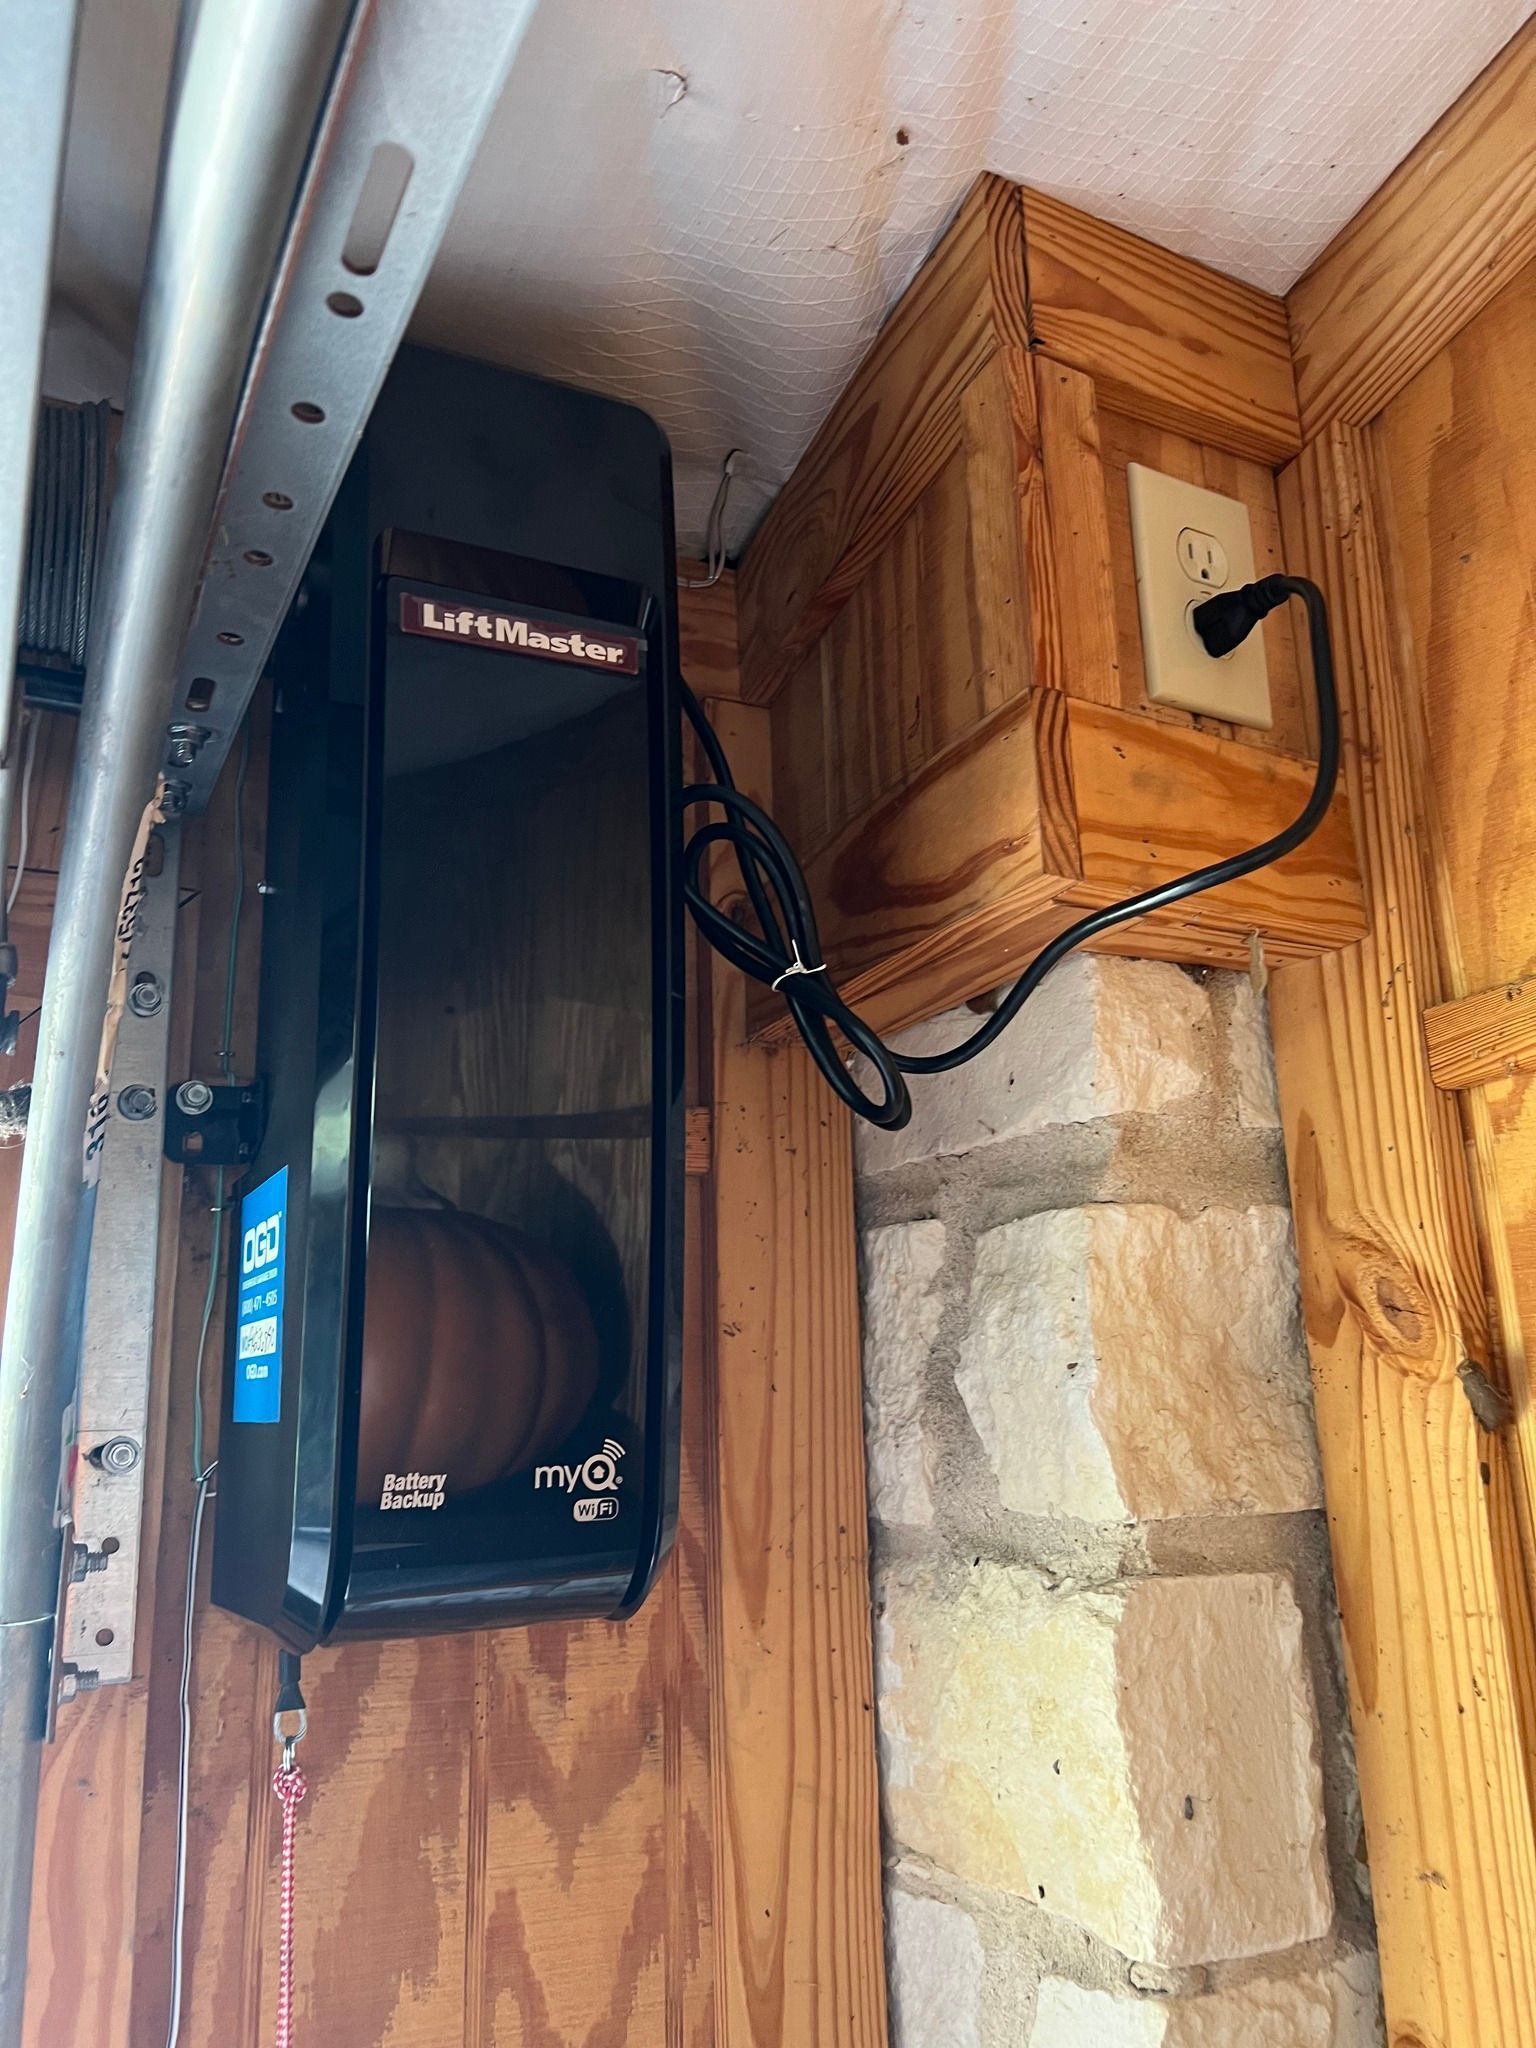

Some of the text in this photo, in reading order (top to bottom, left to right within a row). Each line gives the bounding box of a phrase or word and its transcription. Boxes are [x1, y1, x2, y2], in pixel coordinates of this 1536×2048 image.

[423, 602, 624, 664] LiftMaster
[383, 1472, 447, 1492] Battery
[534, 1453, 619, 1493] myQ
[379, 1490, 445, 1511] Backup
